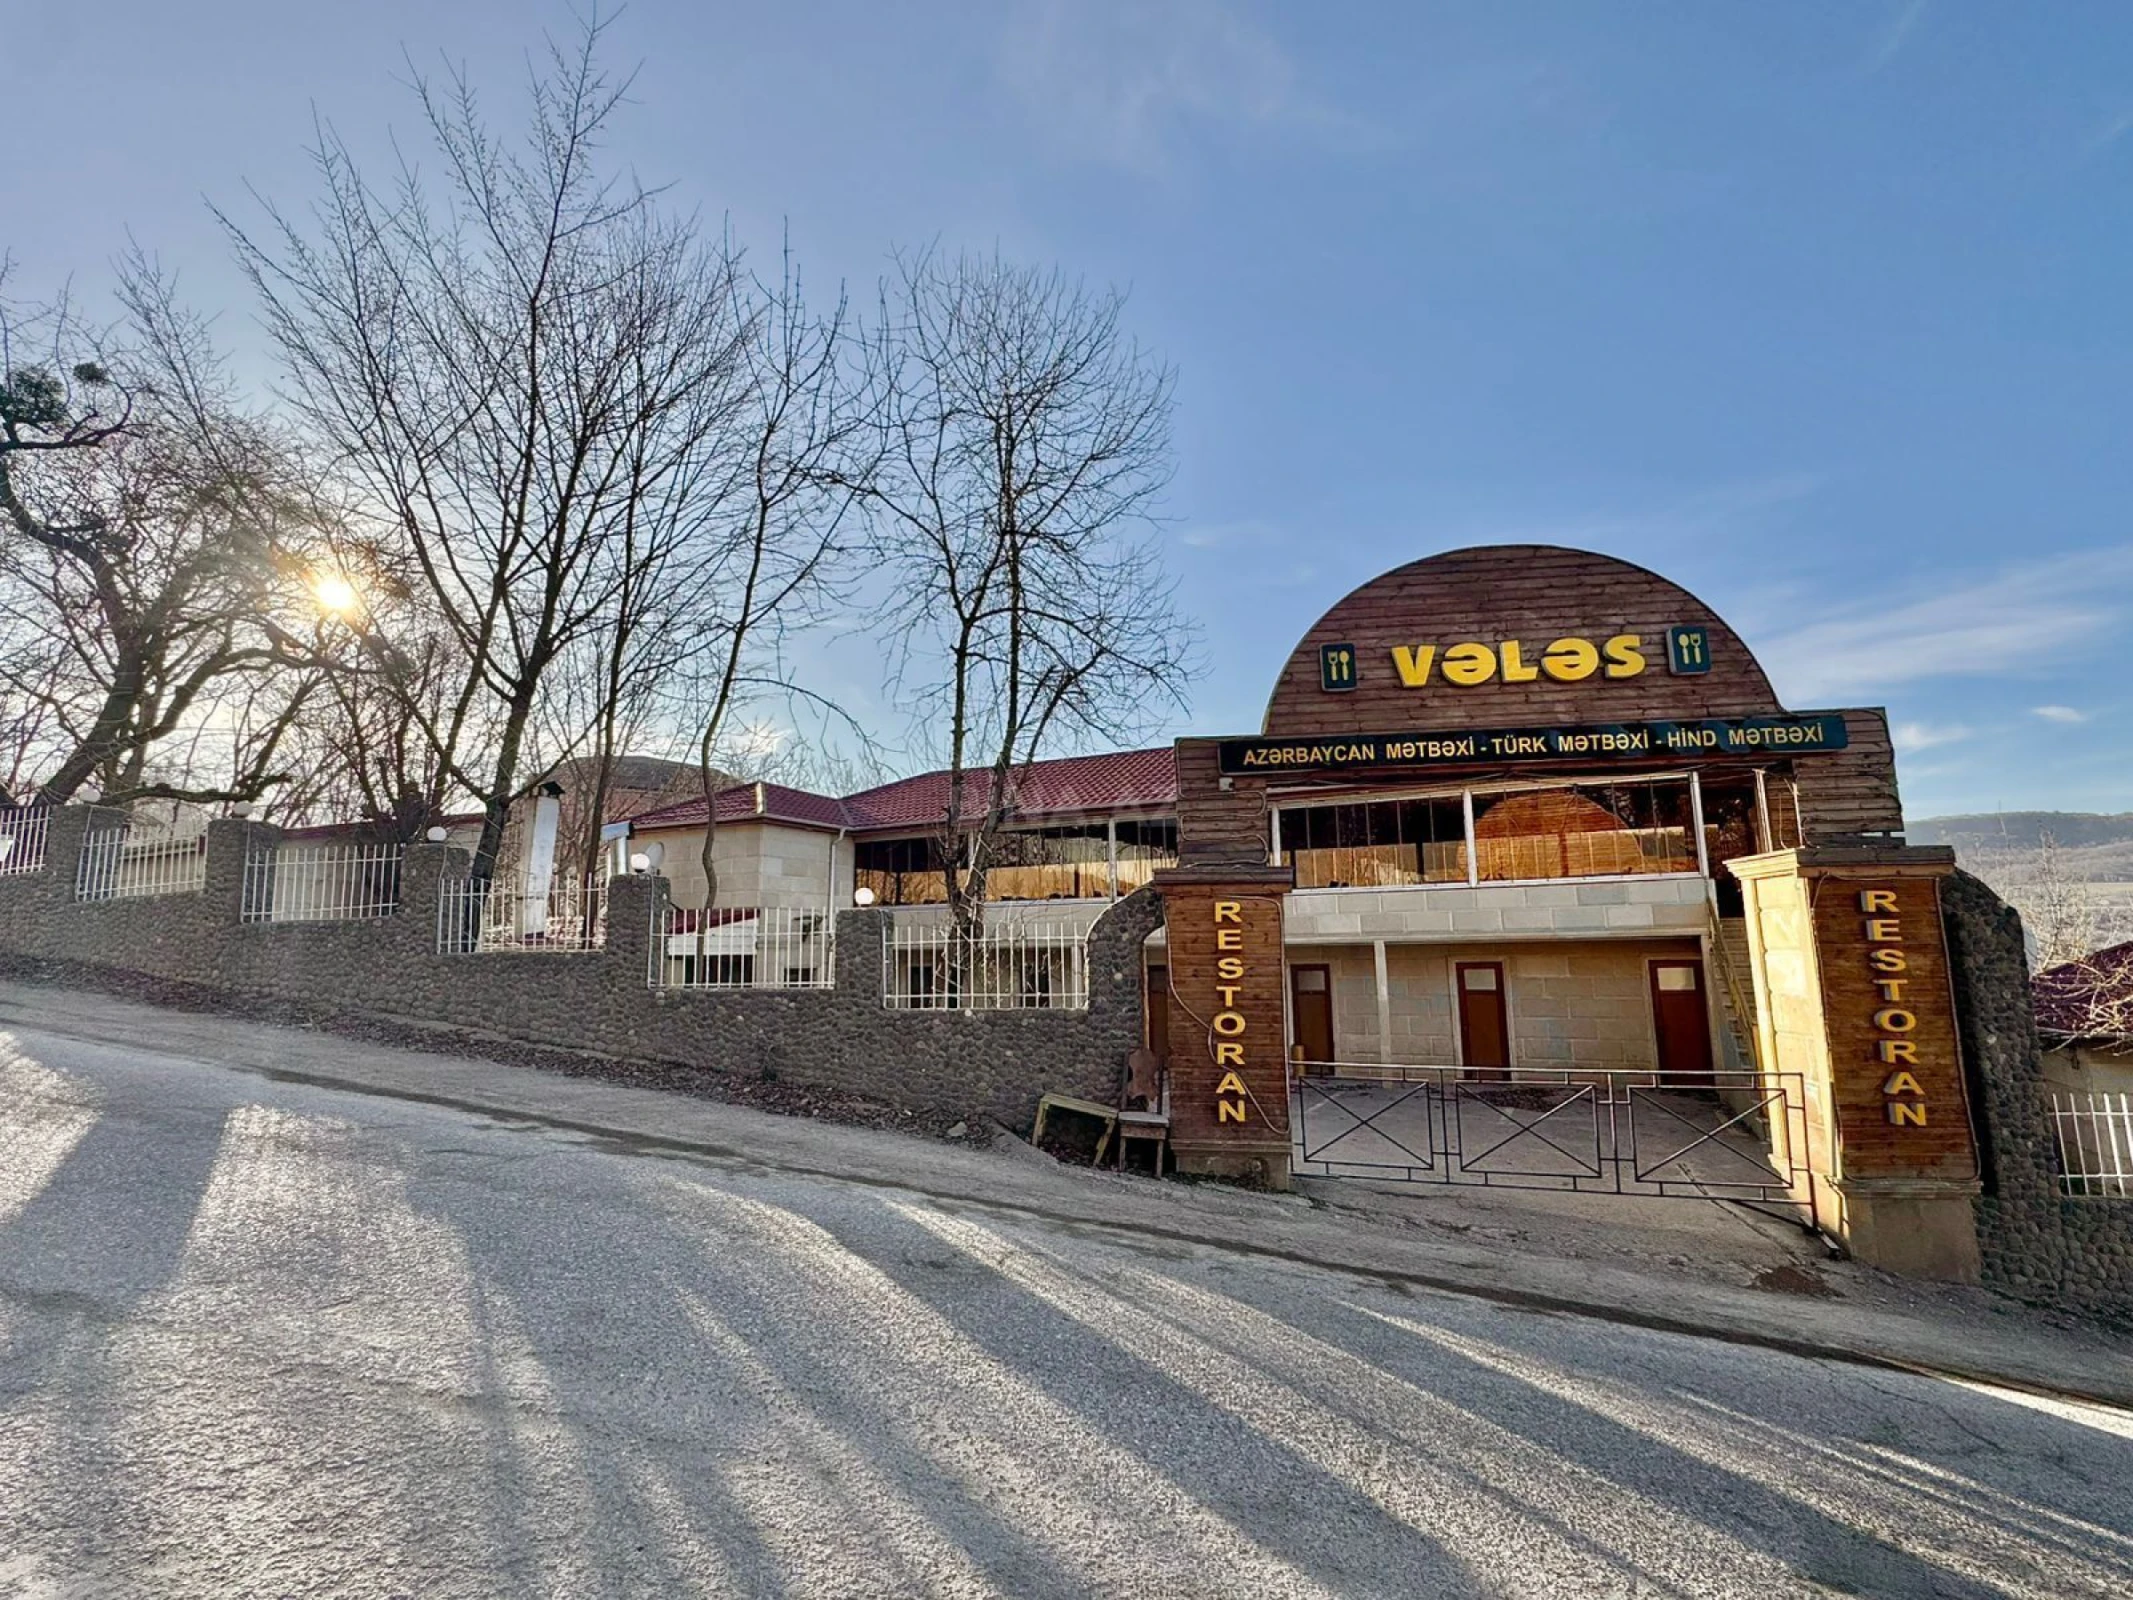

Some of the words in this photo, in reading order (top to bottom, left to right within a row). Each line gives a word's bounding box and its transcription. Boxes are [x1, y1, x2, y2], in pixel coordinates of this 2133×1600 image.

[1391, 634, 1646, 688] VƏLƏS
[1243, 743, 1376, 765] AZƏRBAYCAN
[1385, 736, 1475, 759] MƏTBƏXİ
[1491, 734, 1547, 755] TÜRK
[1557, 728, 1649, 752] MƏTBƏXİ
[1668, 726, 1717, 748] HİND
[1728, 721, 1824, 745] MƏTBƏXİ
[1213, 901, 1246, 1123] RESTORAN
[1862, 889, 1928, 1126] RESTORAN
